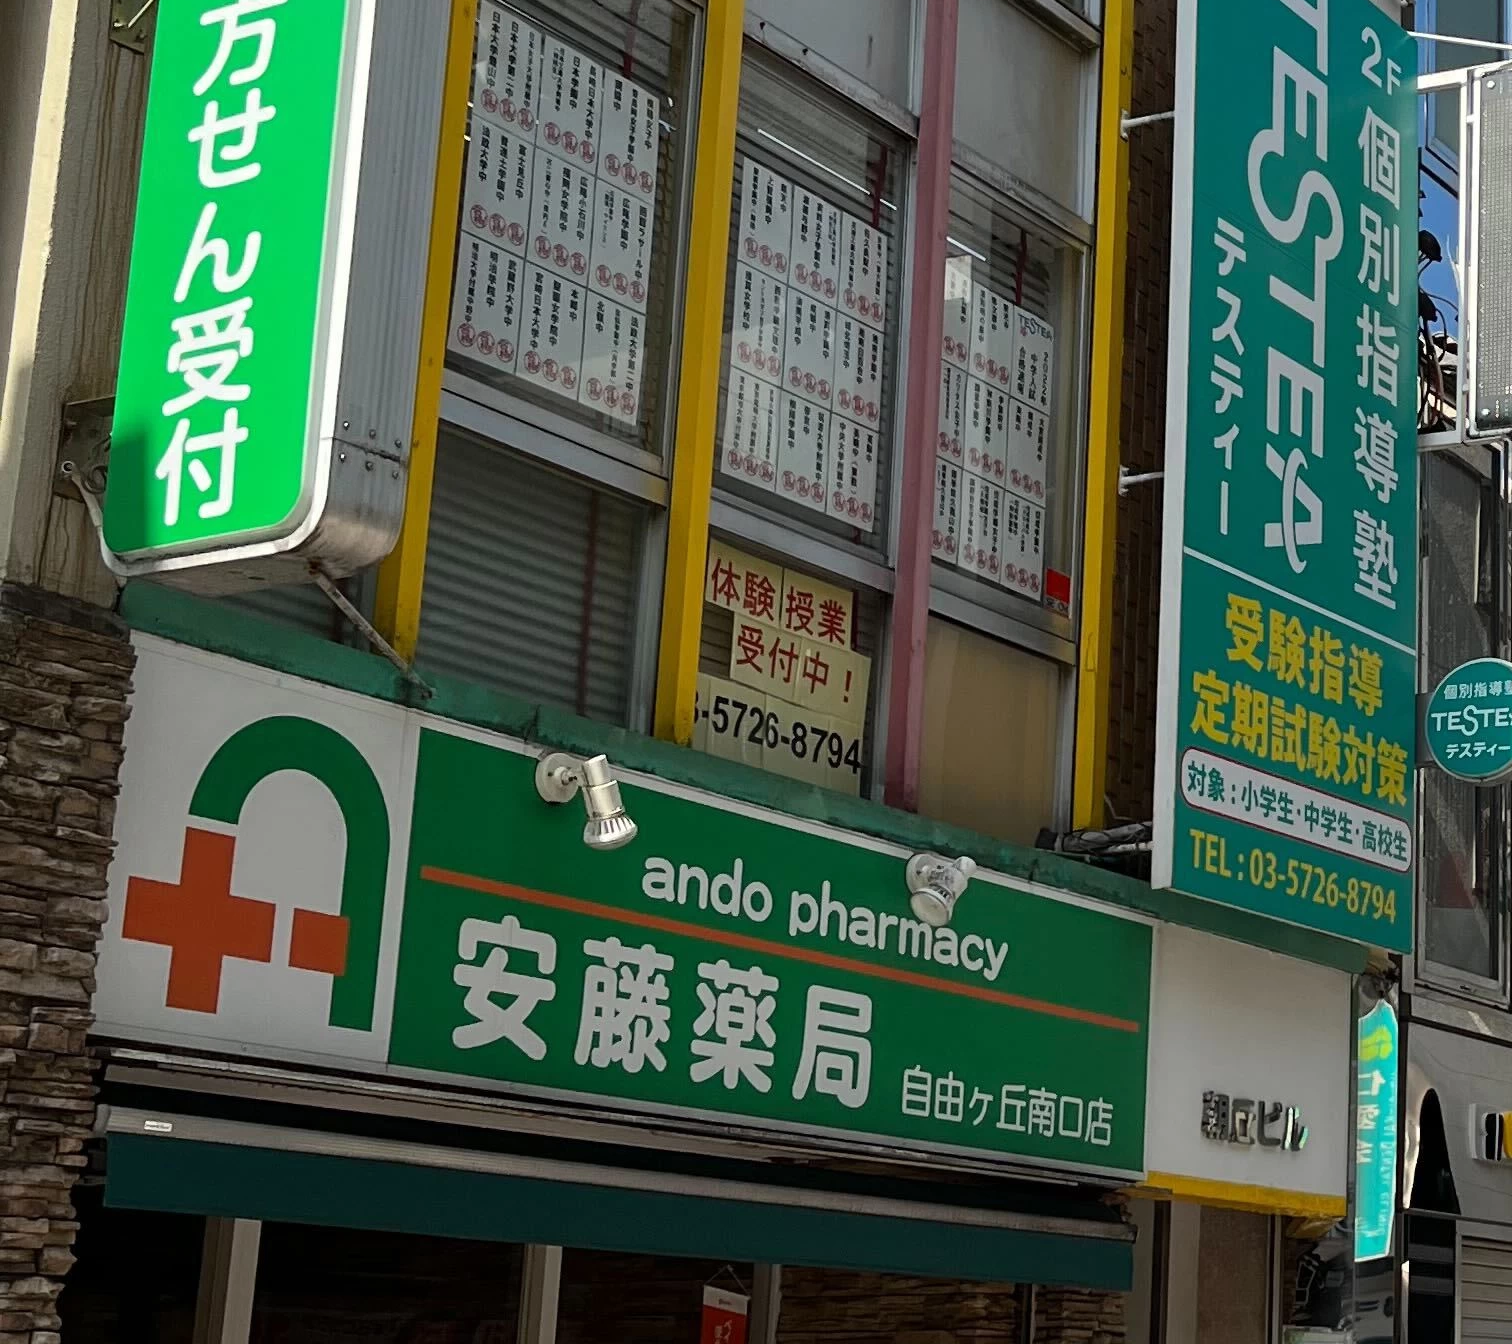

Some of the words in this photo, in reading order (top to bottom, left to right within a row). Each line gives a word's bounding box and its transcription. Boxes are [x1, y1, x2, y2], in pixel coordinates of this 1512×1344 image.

[1210, 218, 1249, 536] テスティー
[1352, 106, 1402, 612] 個別指導塾
[711, 558, 847, 646] 体験授業
[1224, 592, 1384, 717] 受験指導
[1190, 670, 1409, 806] 定期試験対策
[1446, 741, 1511, 759] テスティー
[641, 857, 773, 924] ando
[788, 889, 1010, 981] pharmacy
[451, 914, 875, 1109] 安藤薬局
